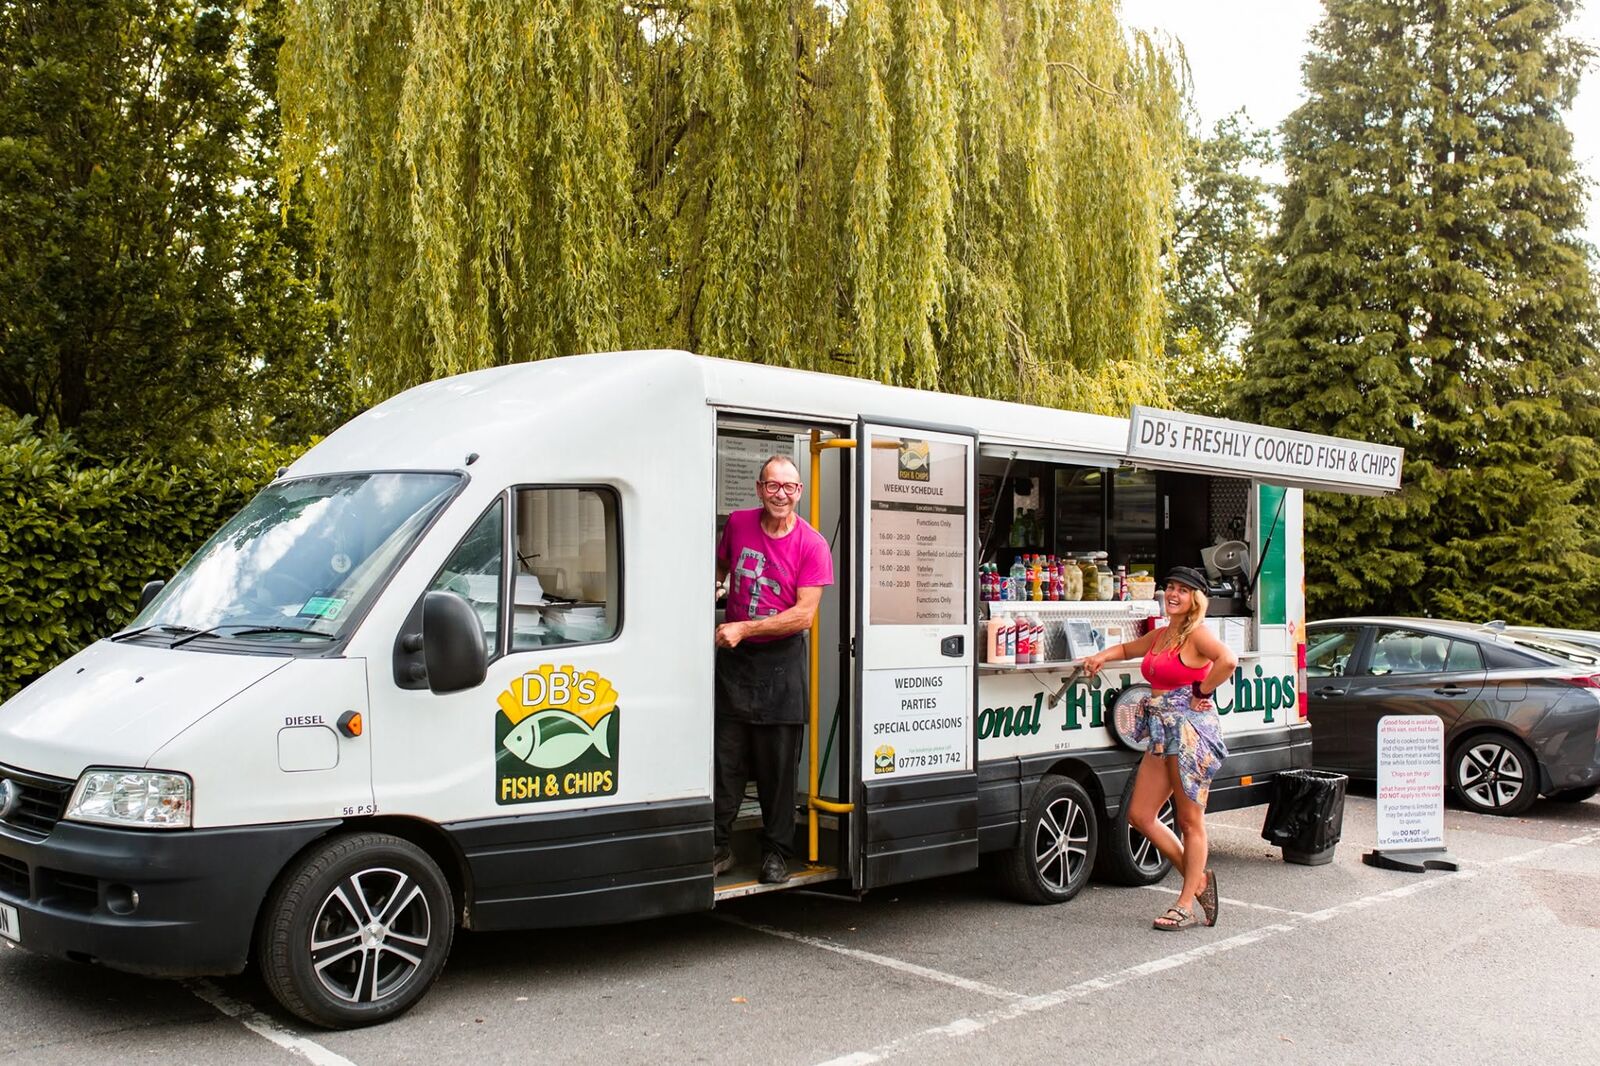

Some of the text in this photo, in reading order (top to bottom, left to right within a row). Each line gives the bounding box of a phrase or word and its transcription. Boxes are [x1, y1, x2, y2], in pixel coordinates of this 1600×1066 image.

[1140, 419, 1396, 477] DB's FRESHLY COOKED FISH & CHIPS
[900, 471, 910, 479] FISH
[915, 472, 928, 480] CHIPS
[884, 484, 944, 496] WEEKLY SCHEDULE
[916, 518, 952, 528] Functions Only
[894, 676, 943, 689] WEDDINGS
[901, 698, 937, 710] PARTIES
[1061, 673, 1131, 731] Fi
[285, 715, 326, 726] DIESEL
[874, 717, 962, 734] SPECIAL OCCASIONS
[898, 752, 960, 768] 07778 291 742
[502, 770, 613, 800] FISH & CHIPS
[343, 806, 354, 816] 56
[0, 906, 10, 933] N
